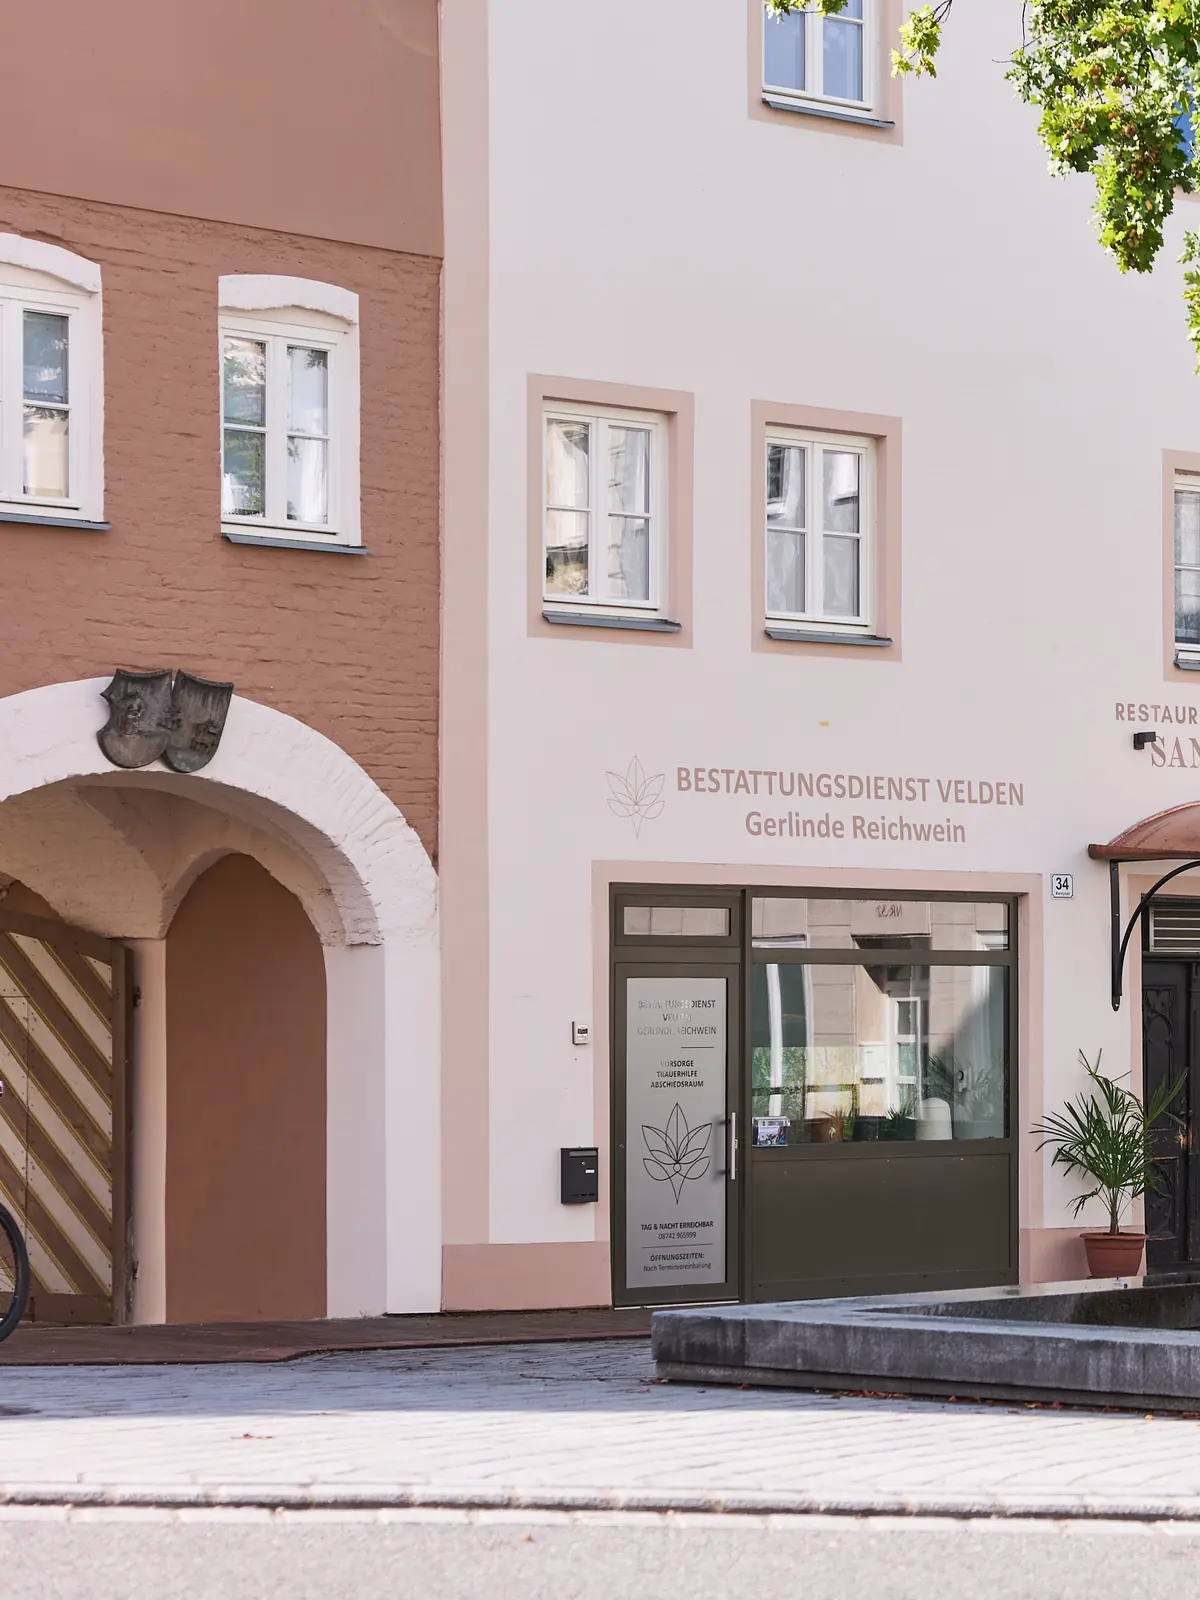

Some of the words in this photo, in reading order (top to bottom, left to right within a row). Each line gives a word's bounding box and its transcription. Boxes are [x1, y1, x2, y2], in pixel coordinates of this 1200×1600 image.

[676, 766, 930, 802] BESTATTUNGSDIENST
[936, 779, 1025, 806] VELDEN
[744, 811, 845, 839] Gerlinde
[852, 815, 966, 843] Reichwein
[1056, 877, 1069, 890] 34
[677, 1026, 717, 1035] EICHWEIN
[650, 1080, 704, 1088] ABSCHIEDSRAUM
[659, 1222, 679, 1230] NACHT
[679, 1221, 714, 1229] ERREICHBAR
